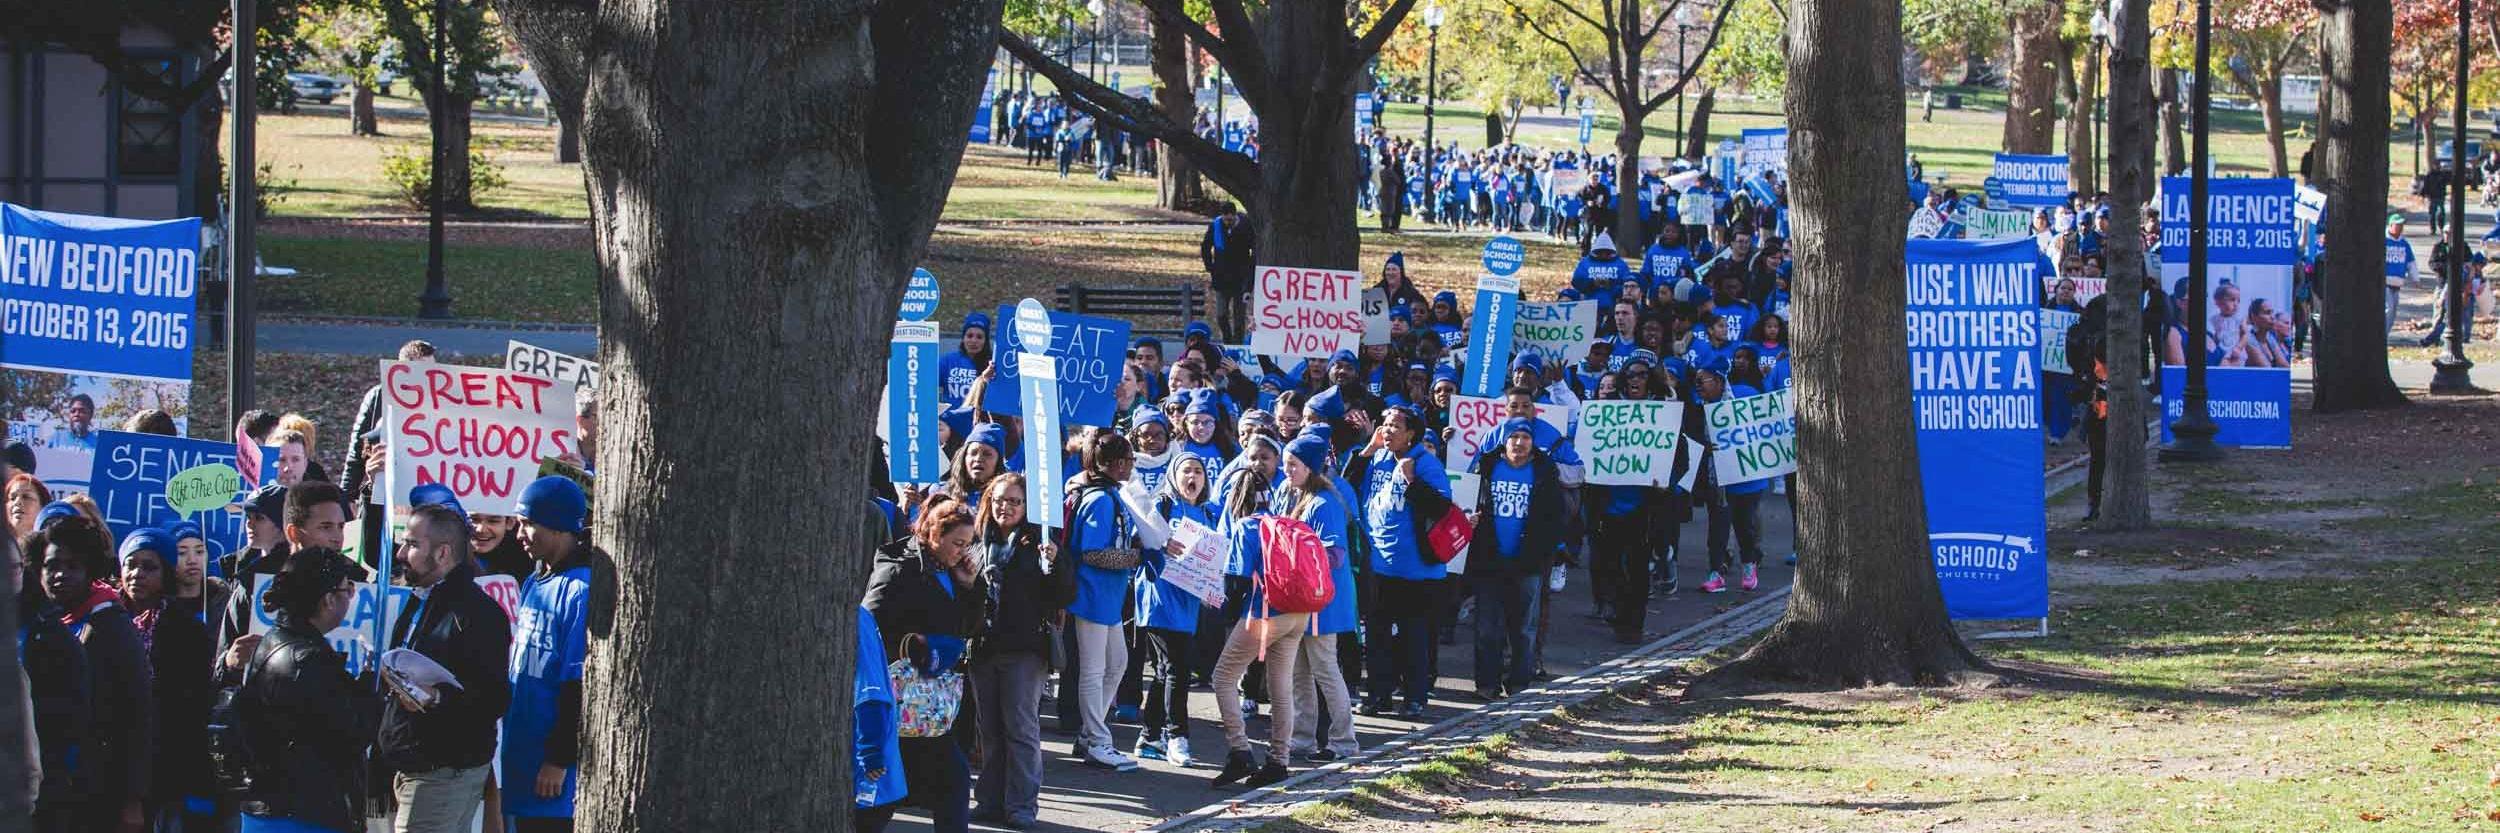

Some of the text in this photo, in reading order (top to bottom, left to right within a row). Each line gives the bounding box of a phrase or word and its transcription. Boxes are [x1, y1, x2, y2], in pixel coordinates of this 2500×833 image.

[1995, 162, 2069, 181] BROCKTON
[1491, 241, 1518, 251] GREAT
[2237, 230, 2250, 250] 3,
[2255, 230, 2292, 249] 2015
[1485, 250, 1522, 262] SCHOOLS
[1491, 260, 1512, 270] NOW
[1653, 255, 1683, 264] GREAT
[61, 241, 196, 298] BEDFORD
[1587, 266, 1618, 275] GREAT
[1262, 269, 1355, 303] GREAT
[1960, 264, 1966, 305] I
[1972, 263, 2036, 305] WANT
[901, 302, 926, 313] NOW
[1514, 302, 1578, 321] REAT
[0, 298, 188, 350] CTOBER 13, 2015
[1512, 321, 1584, 342] CHOOLS
[1907, 311, 2037, 348] BROTHERS
[1007, 317, 1116, 358] GEAT
[1284, 333, 1340, 354] NOW
[1478, 293, 1501, 394] DORCHESTER
[950, 367, 977, 377] GRE
[1913, 351, 2036, 390] HAVE A
[387, 364, 553, 415] GREAT
[947, 384, 971, 399] NO
[907, 345, 920, 480] ROSLINDALE
[1584, 403, 1664, 428] GREAT
[1711, 390, 1787, 429] GREAT
[1921, 394, 2039, 430] HIGH SCHOOL
[402, 413, 570, 465] SCHOOLS
[1592, 428, 1675, 453] SCHOOLS
[1592, 453, 1651, 477] NOW
[1736, 437, 1797, 477] NOW
[190, 477, 214, 499] The
[215, 473, 237, 499] Cap
[416, 460, 516, 498] NOW
[1937, 545, 2020, 571] SCHOOLS
[1936, 571, 2001, 580] CHUSETTS
